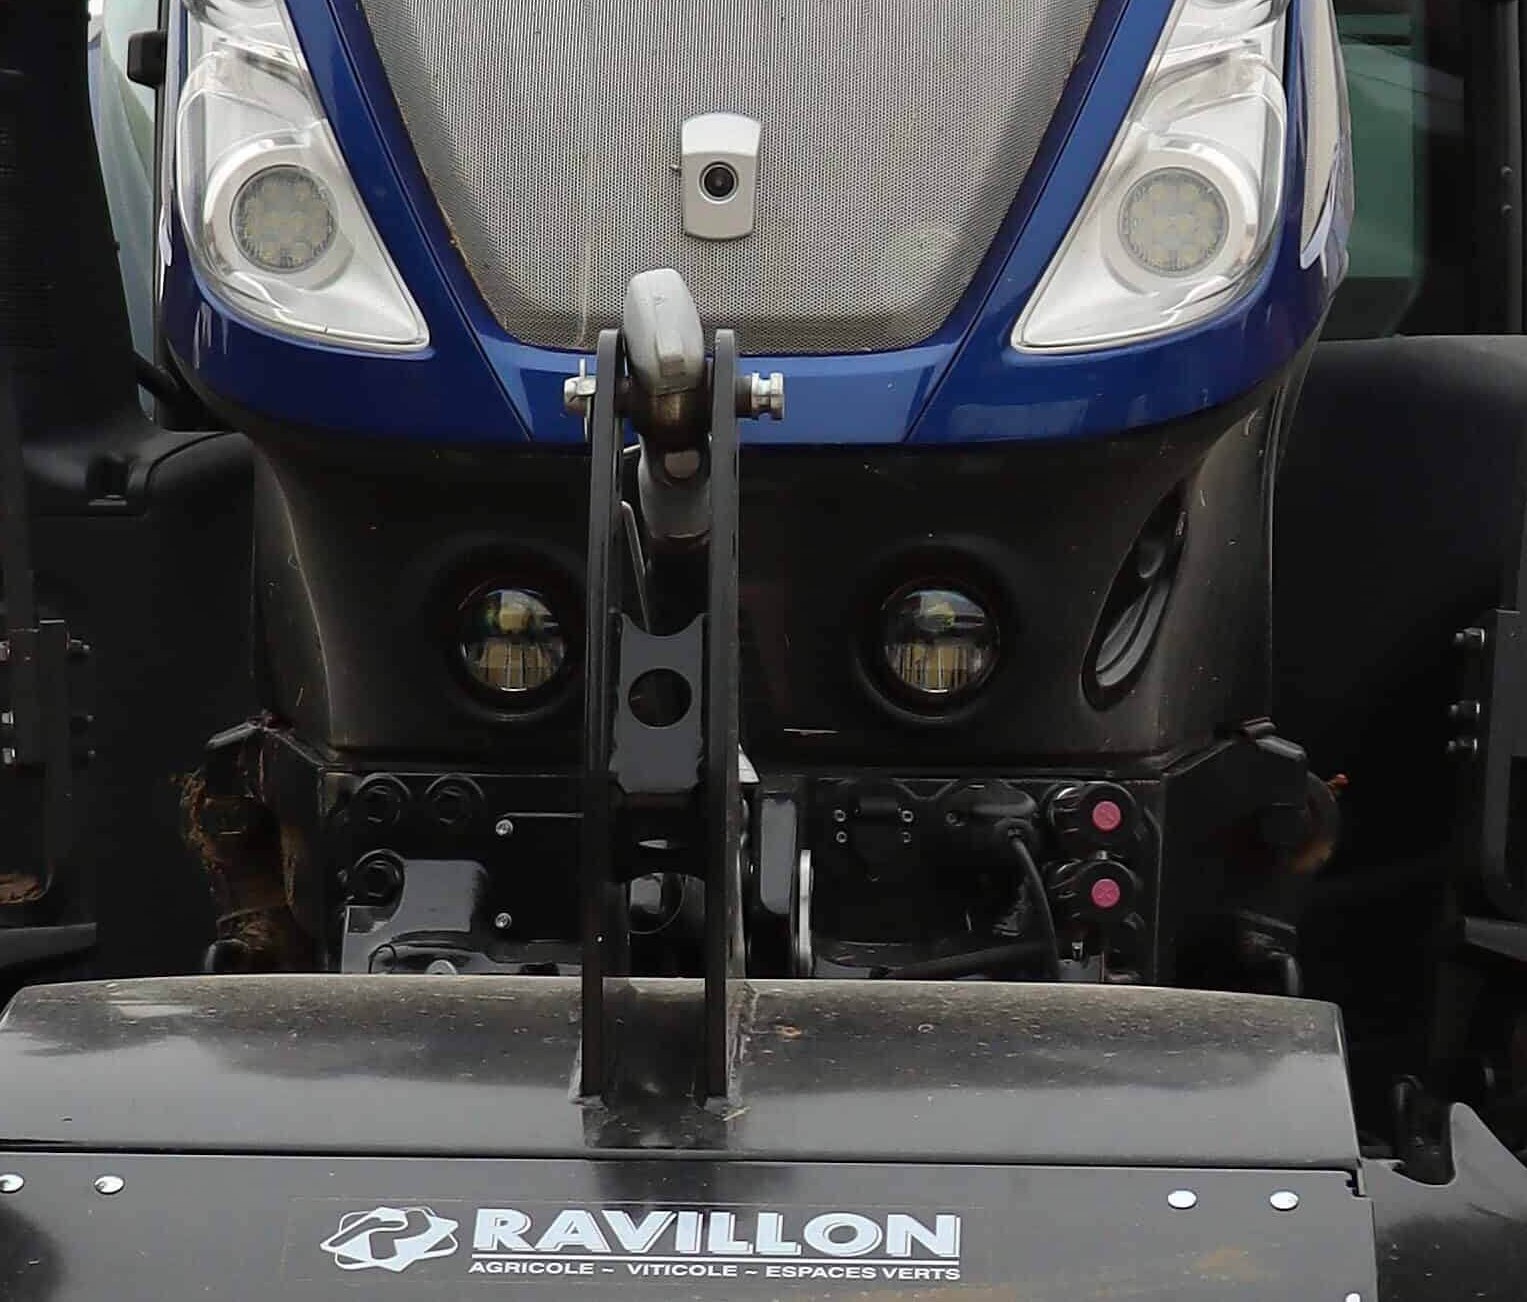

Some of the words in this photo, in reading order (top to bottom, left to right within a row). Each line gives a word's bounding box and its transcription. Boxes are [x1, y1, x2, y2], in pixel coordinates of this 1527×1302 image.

[471, 1208, 962, 1258] RAVILLON
[468, 1260, 595, 1275] AGRICOLE
[626, 1262, 738, 1277] VITICOLE
[765, 1265, 878, 1279] ESPACES
[882, 1267, 961, 1280] VERTS
